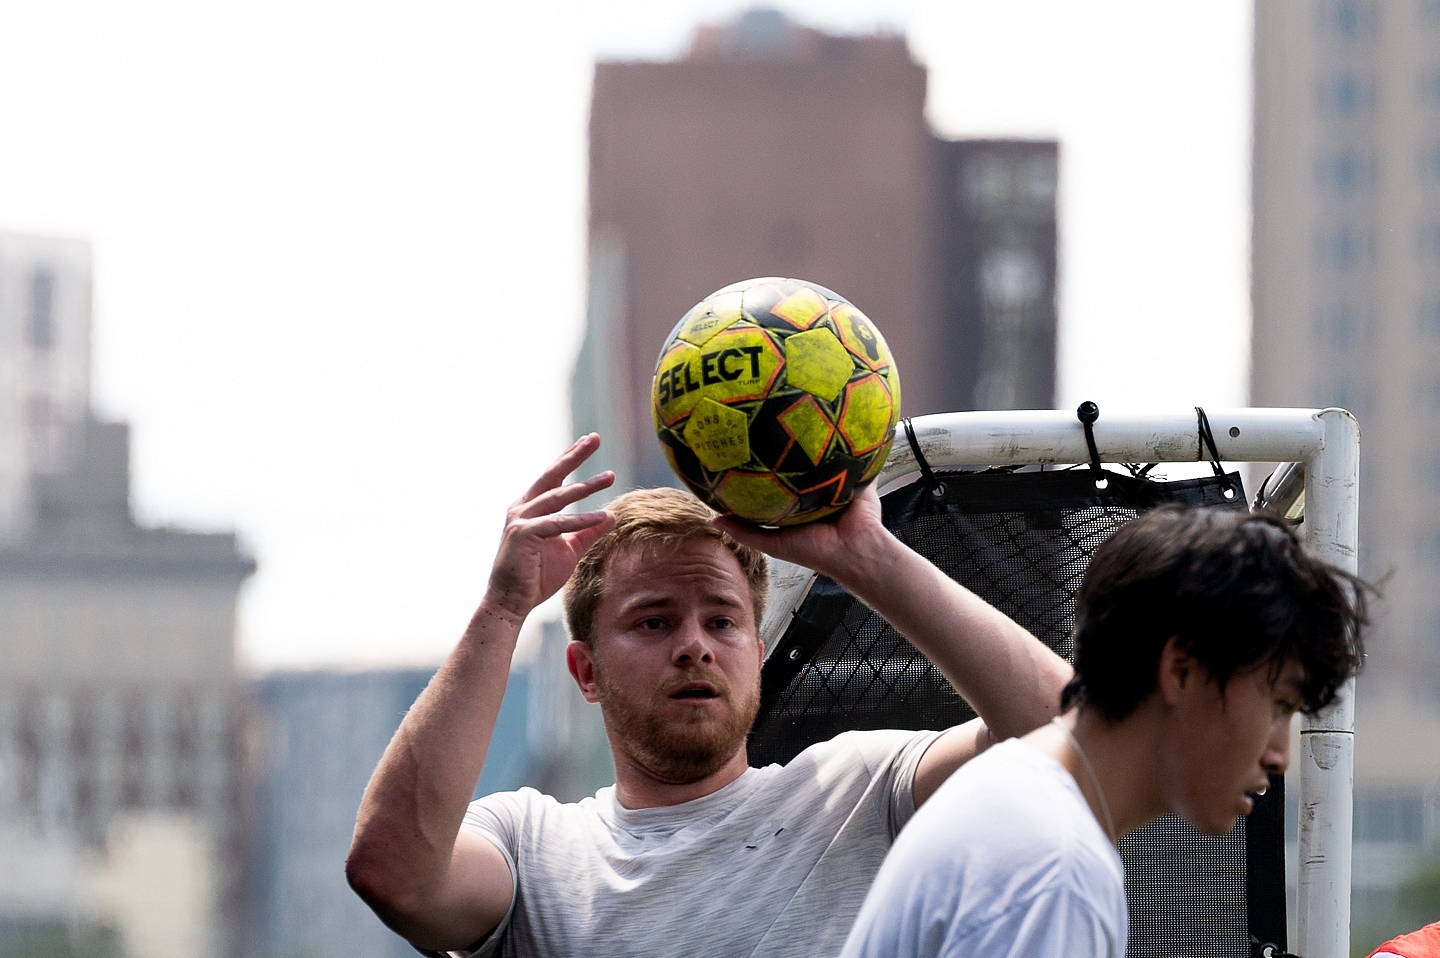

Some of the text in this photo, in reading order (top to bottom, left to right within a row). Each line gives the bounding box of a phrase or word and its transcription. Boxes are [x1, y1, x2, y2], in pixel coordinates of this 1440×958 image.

[690, 320, 720, 333] SELECT
[658, 346, 763, 407] SELECT
[693, 414, 720, 438] SONS
[694, 435, 744, 451] PITCHES
